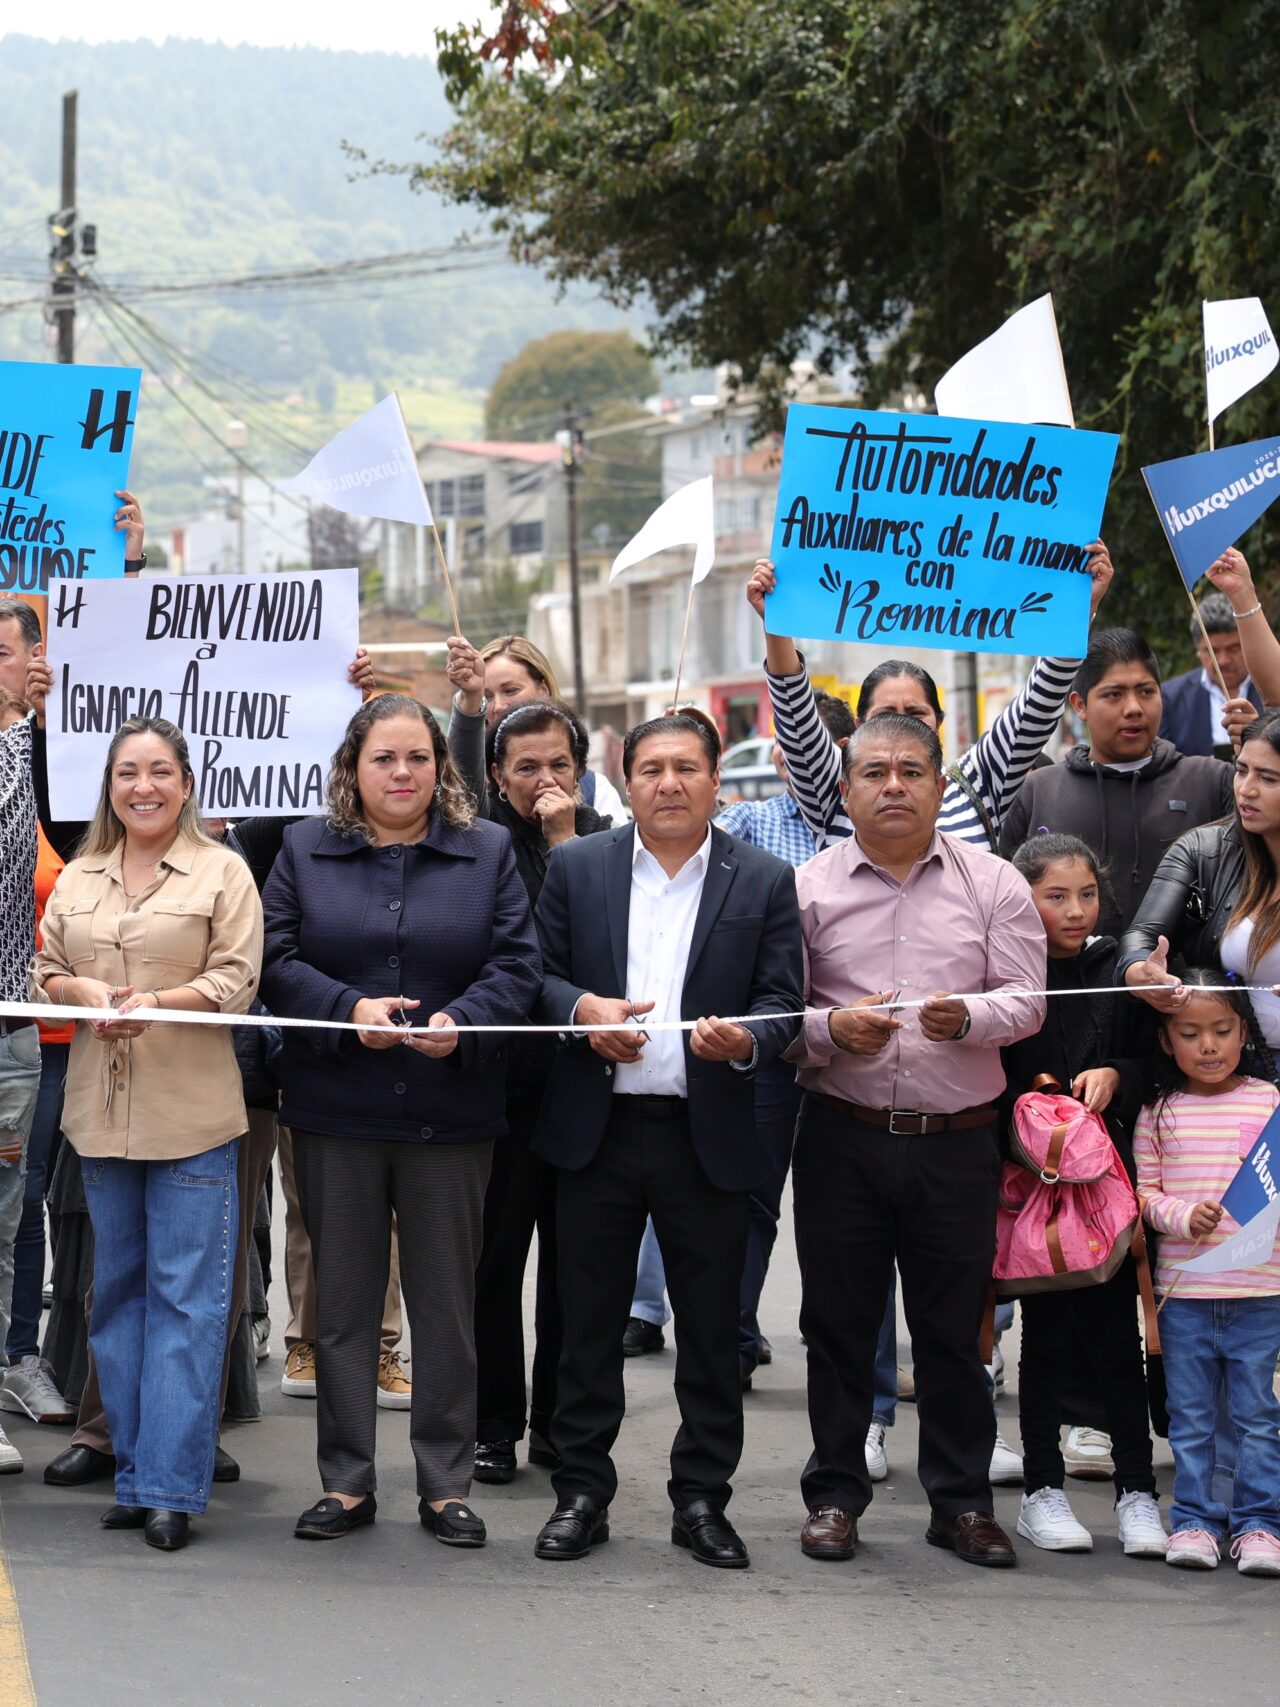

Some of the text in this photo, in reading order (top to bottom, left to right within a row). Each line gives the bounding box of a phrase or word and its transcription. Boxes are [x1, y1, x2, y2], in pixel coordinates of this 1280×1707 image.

[781, 493, 1091, 575] Auxiliares de la mano
[905, 560, 954, 590] con
[146, 579, 323, 642] BIENVENIDA
[195, 642, 218, 660] a
[61, 660, 292, 740] IGNACIO ALLENDE
[199, 740, 323, 809] ROMINA
